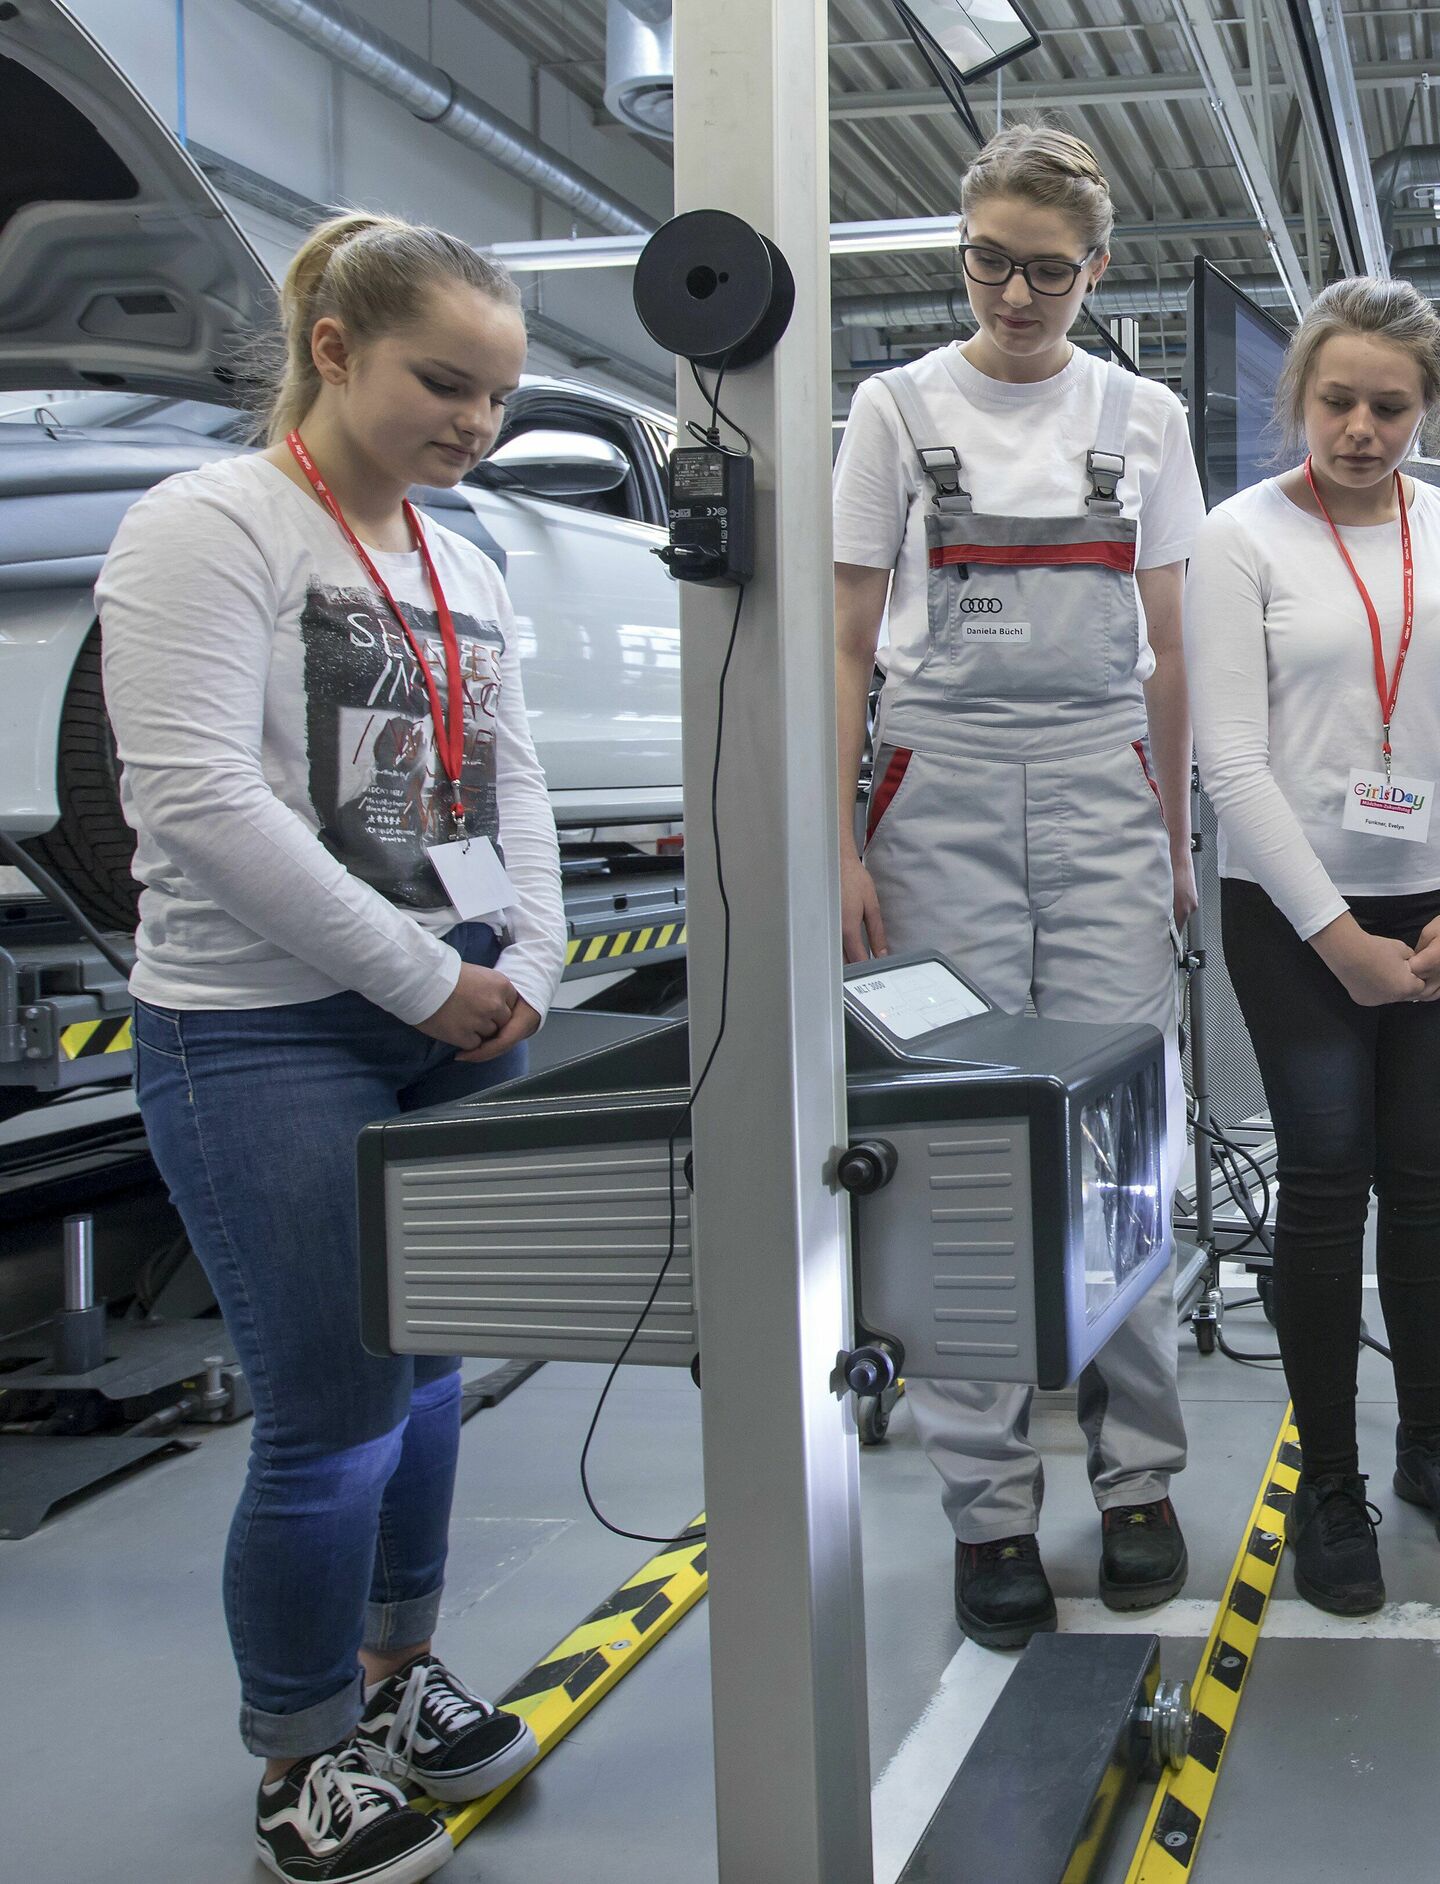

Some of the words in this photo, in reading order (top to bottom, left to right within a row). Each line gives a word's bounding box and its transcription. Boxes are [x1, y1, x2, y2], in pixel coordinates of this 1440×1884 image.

[966, 627, 997, 635] Daniela
[999, 627, 1023, 635] Büchl
[1388, 821, 1405, 830] Evelyn
[854, 982, 871, 995] MLT
